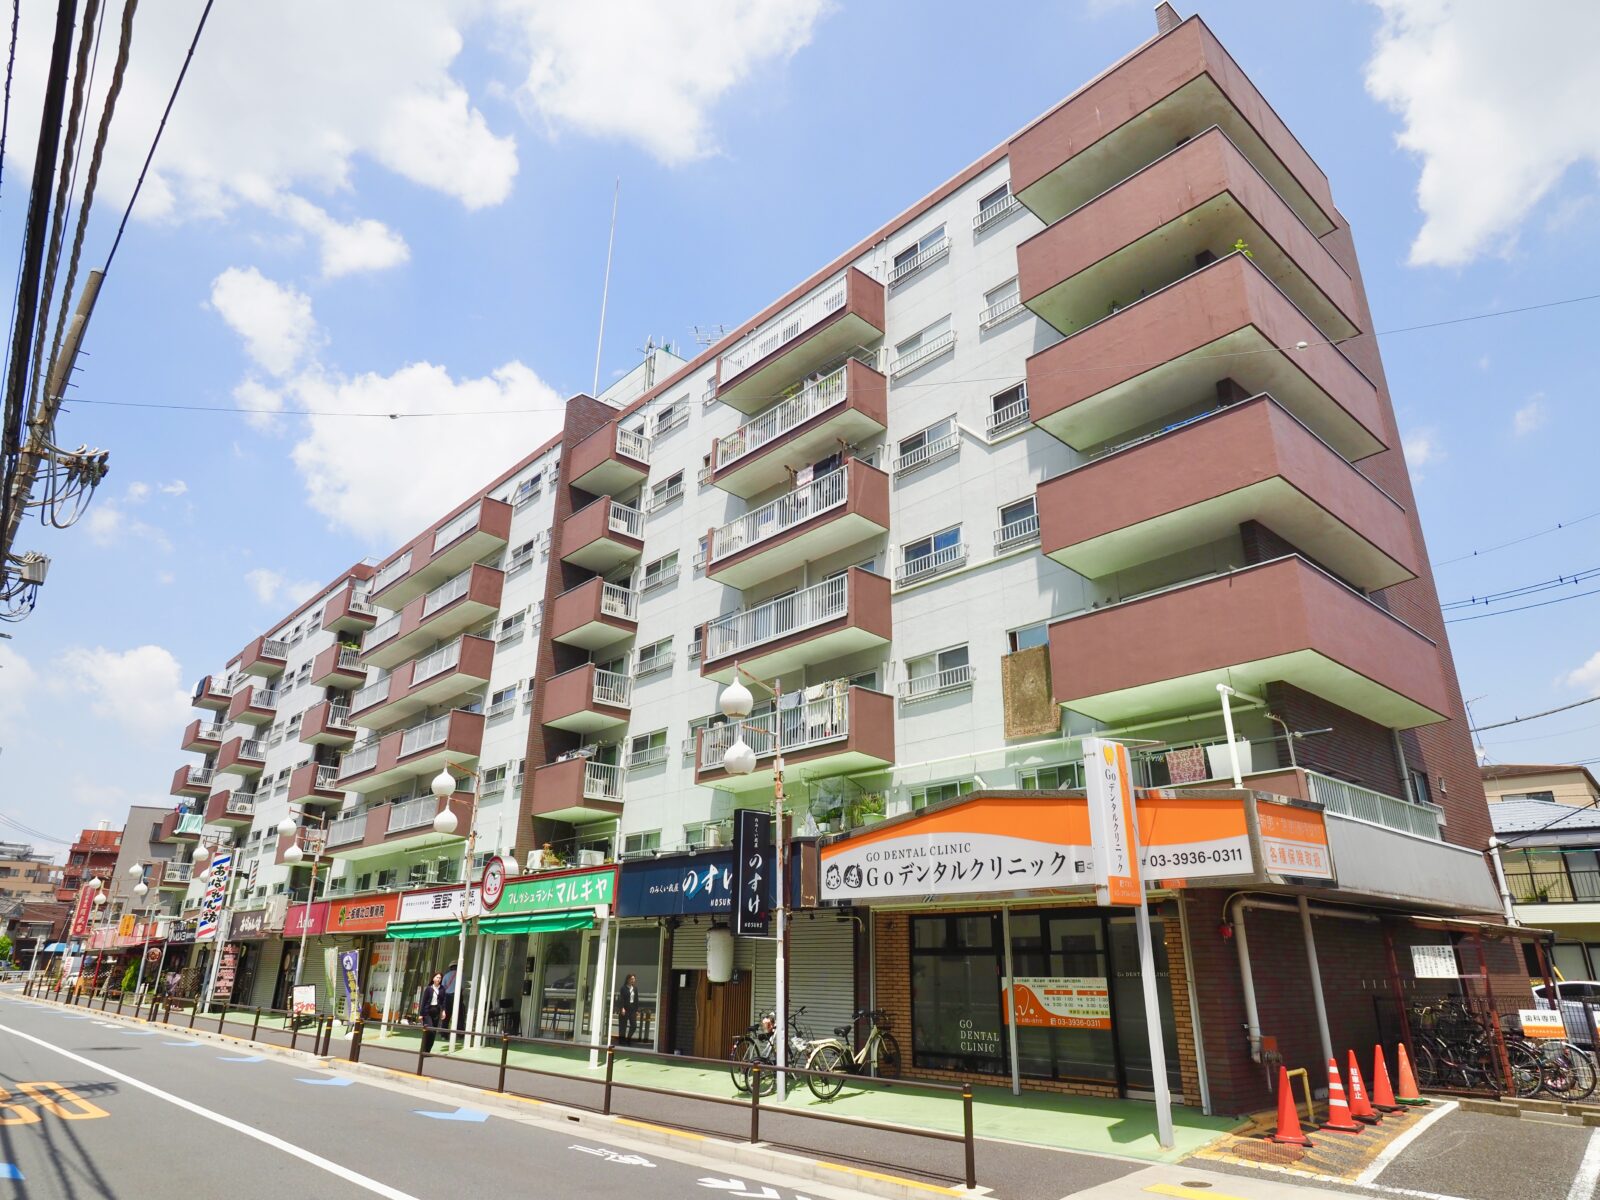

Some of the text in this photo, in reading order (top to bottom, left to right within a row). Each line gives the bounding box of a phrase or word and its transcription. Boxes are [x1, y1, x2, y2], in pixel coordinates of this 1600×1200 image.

[866, 842, 972, 862] GO DENTAL CLINIC
[1150, 848, 1243, 867] 03-3936-0311
[747, 853, 763, 914] のすけ
[203, 864, 226, 923] あばれん坊
[508, 888, 554, 904] フレッシュランド
[710, 898, 731, 907] NOSUK
[959, 1019, 973, 1029] GO
[1058, 1018, 1101, 1027] 03-3936-0311
[960, 1030, 1000, 1042] DENTAL
[960, 1041, 995, 1053] CLINIC
